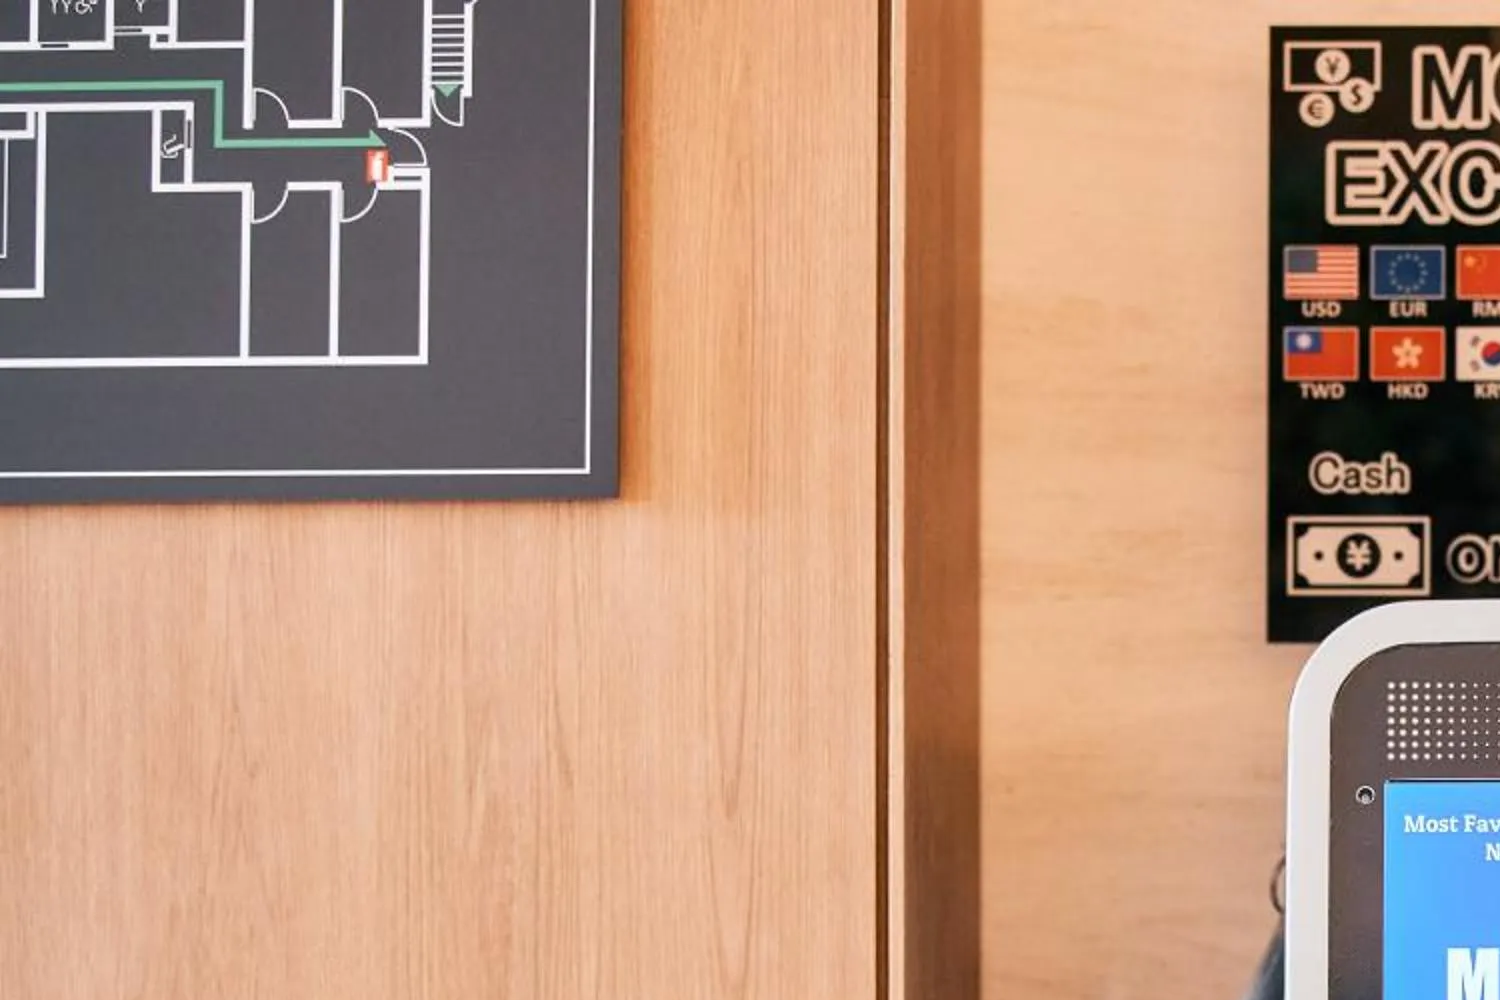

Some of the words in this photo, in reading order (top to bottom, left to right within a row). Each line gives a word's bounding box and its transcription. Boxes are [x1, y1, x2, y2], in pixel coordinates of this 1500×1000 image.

[1301, 301, 1341, 319] USD
[1389, 301, 1428, 319] EUR
[1300, 383, 1345, 400] TWD
[1387, 383, 1429, 400] HKD
[1308, 451, 1412, 495] Cash
[1403, 814, 1457, 833] Most
